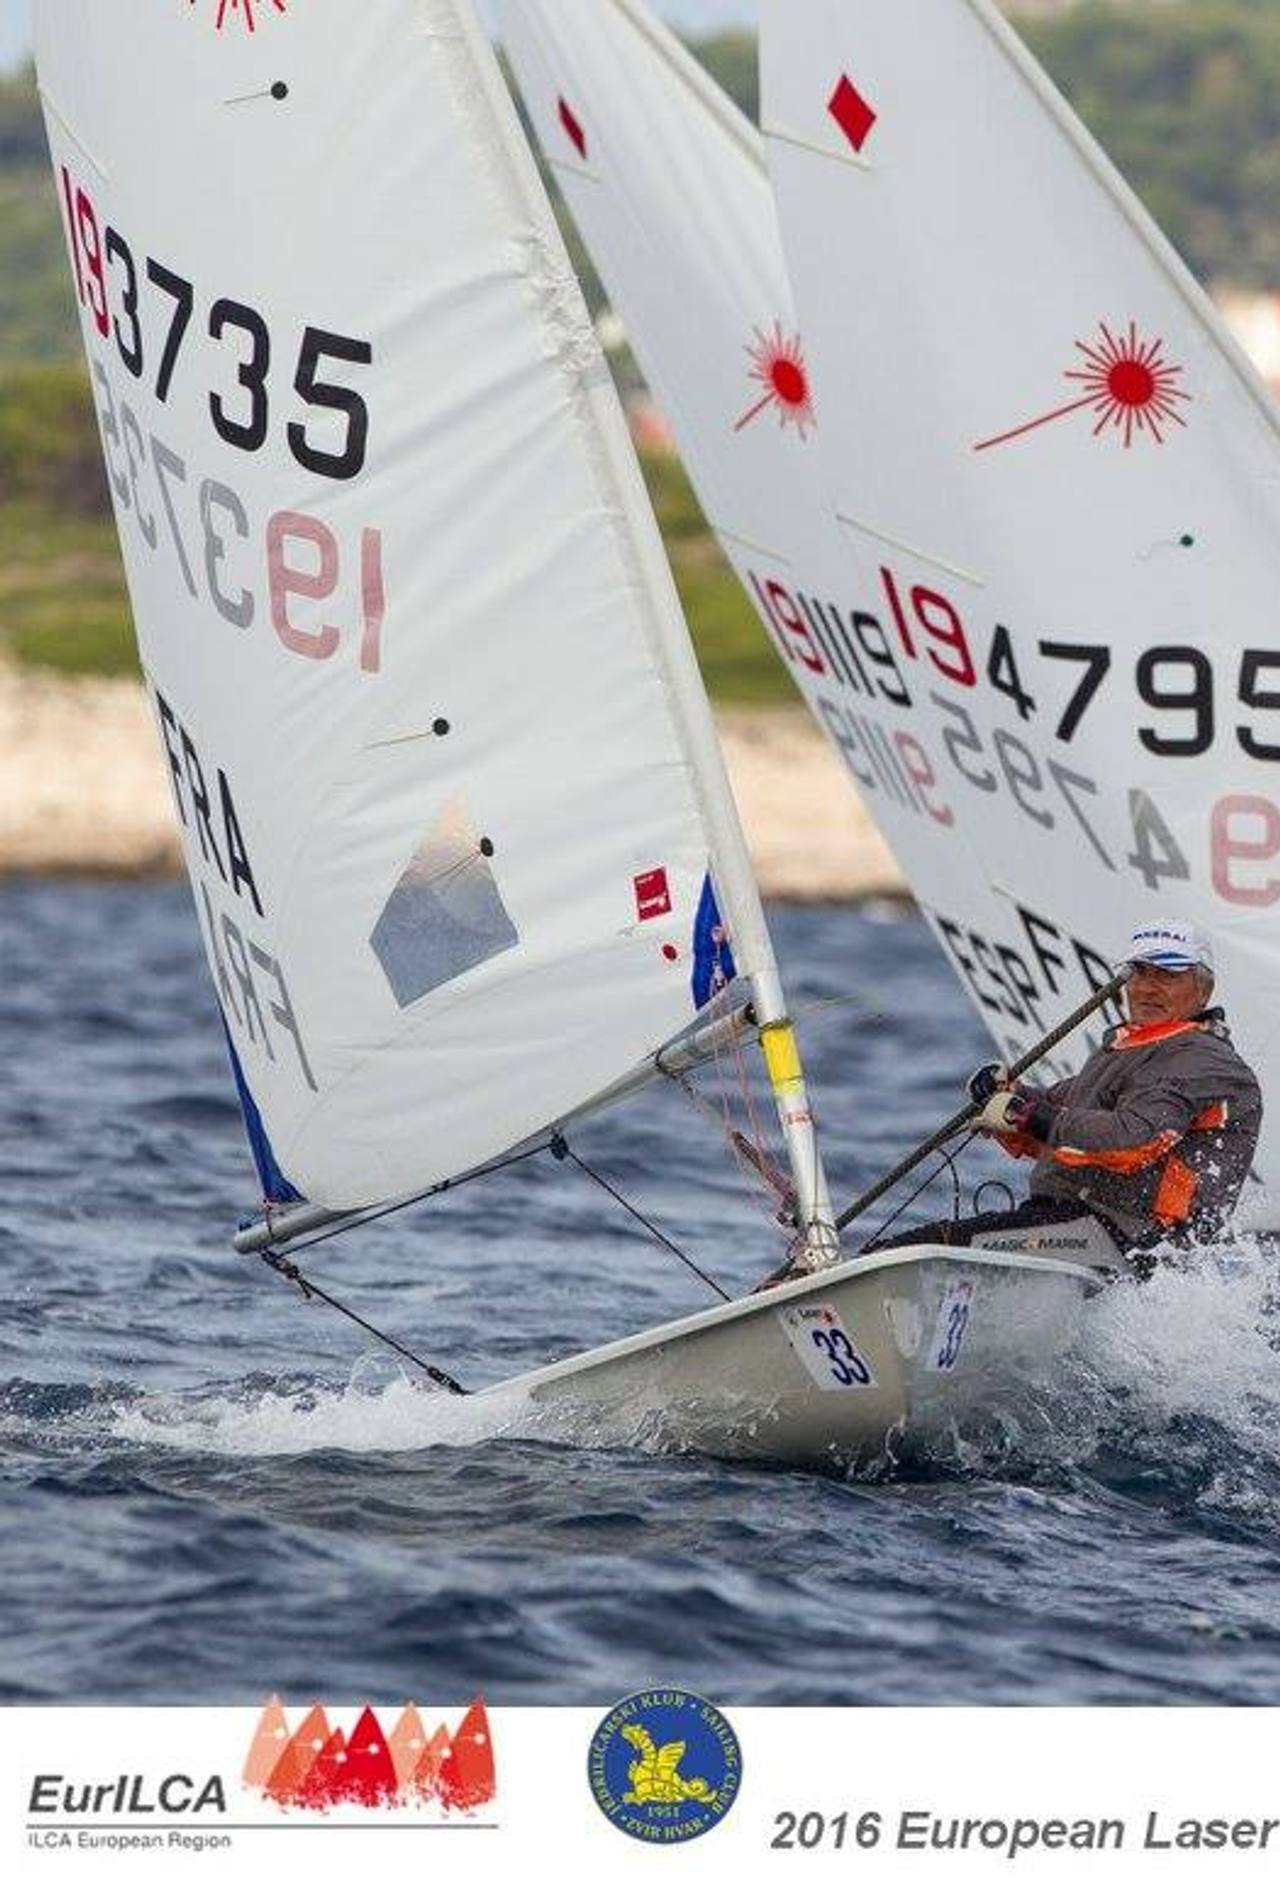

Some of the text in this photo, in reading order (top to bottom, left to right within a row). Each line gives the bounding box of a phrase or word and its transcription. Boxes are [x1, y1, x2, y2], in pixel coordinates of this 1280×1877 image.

[60, 165, 373, 481] 193735
[748, 570, 912, 708] 191119
[156, 689, 265, 917] FRA
[936, 914, 1047, 1035] ESP
[1016, 903, 1128, 1028] FR
[811, 1328, 871, 1386] 33
[937, 1303, 969, 1369] 33
